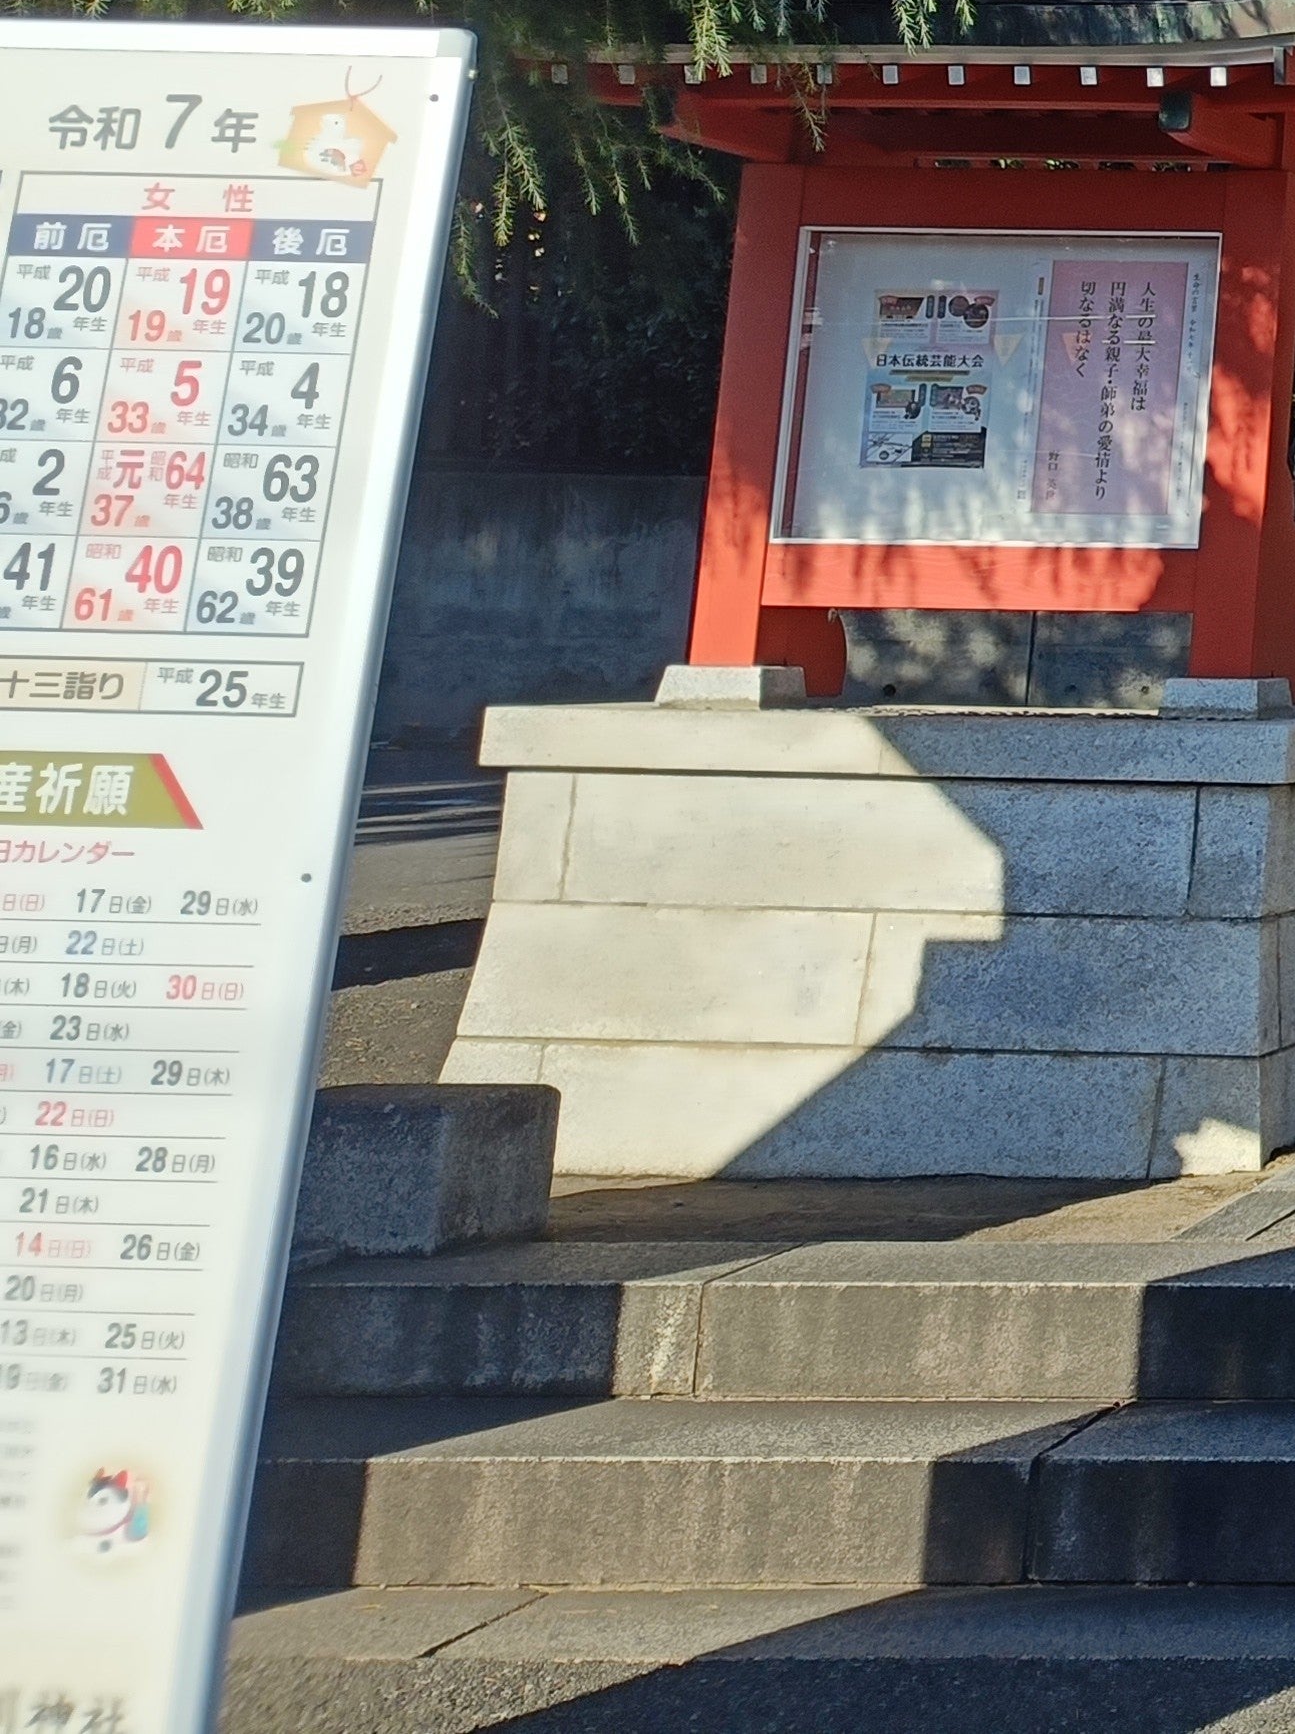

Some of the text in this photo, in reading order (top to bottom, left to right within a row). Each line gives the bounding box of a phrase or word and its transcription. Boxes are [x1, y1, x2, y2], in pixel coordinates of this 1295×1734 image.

[48, 94, 259, 153] 令和7年
[33, 221, 351, 256] 前厄 本厄 後厄
[17, 264, 112, 313] 平成 20
[136, 266, 231, 315] 平成 19
[255, 269, 350, 318] 平成 18
[72, 316, 108, 332] 年生
[192, 319, 227, 335] 年生
[312, 322, 347, 337] 年生
[1076, 281, 1096, 378] 切なるはなく
[51, 356, 83, 404] 6
[876, 354, 984, 368] 日本伝統芸能大会
[120, 358, 203, 407] 平成 5
[239, 360, 320, 410] 平成 4
[56, 408, 91, 424] 年生
[176, 411, 212, 427] 年生
[296, 414, 332, 429] 年生
[32, 448, 65, 496] 2
[112, 449, 145, 489] 元
[165, 450, 206, 490] 64
[223, 452, 320, 503] 昭和 63
[39, 501, 74, 517] 年生
[163, 493, 198, 510] 年生
[281, 507, 317, 523] 年生
[3, 542, 56, 591] 41
[85, 543, 183, 594] 昭和 40
[207, 546, 305, 597] 昭和 39
[21, 595, 56, 611] 年生
[143, 598, 179, 614] 年生
[265, 601, 300, 617] 年生
[0, 670, 124, 700] 十三詣り
[157, 667, 286, 709] 平成 25 年生
